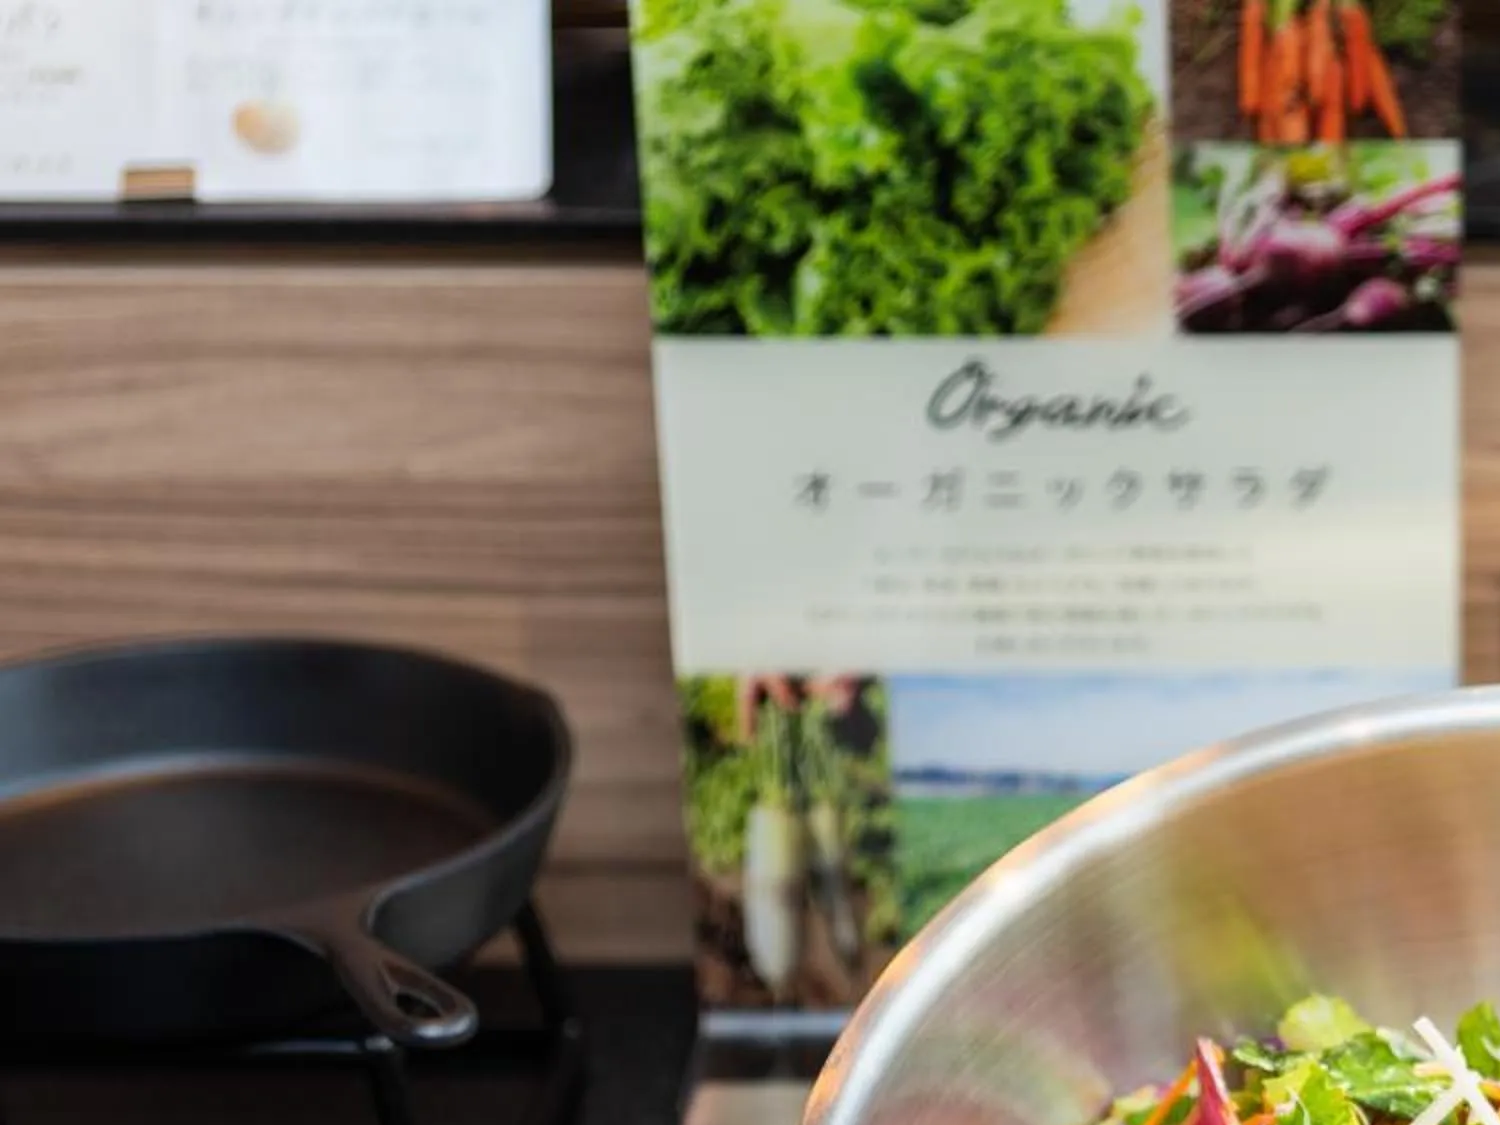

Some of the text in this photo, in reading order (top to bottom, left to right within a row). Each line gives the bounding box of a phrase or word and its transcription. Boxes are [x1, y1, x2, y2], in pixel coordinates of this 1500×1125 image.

[926, 359, 1190, 443] Organic
[794, 463, 1331, 511] オーガニックサラダ
